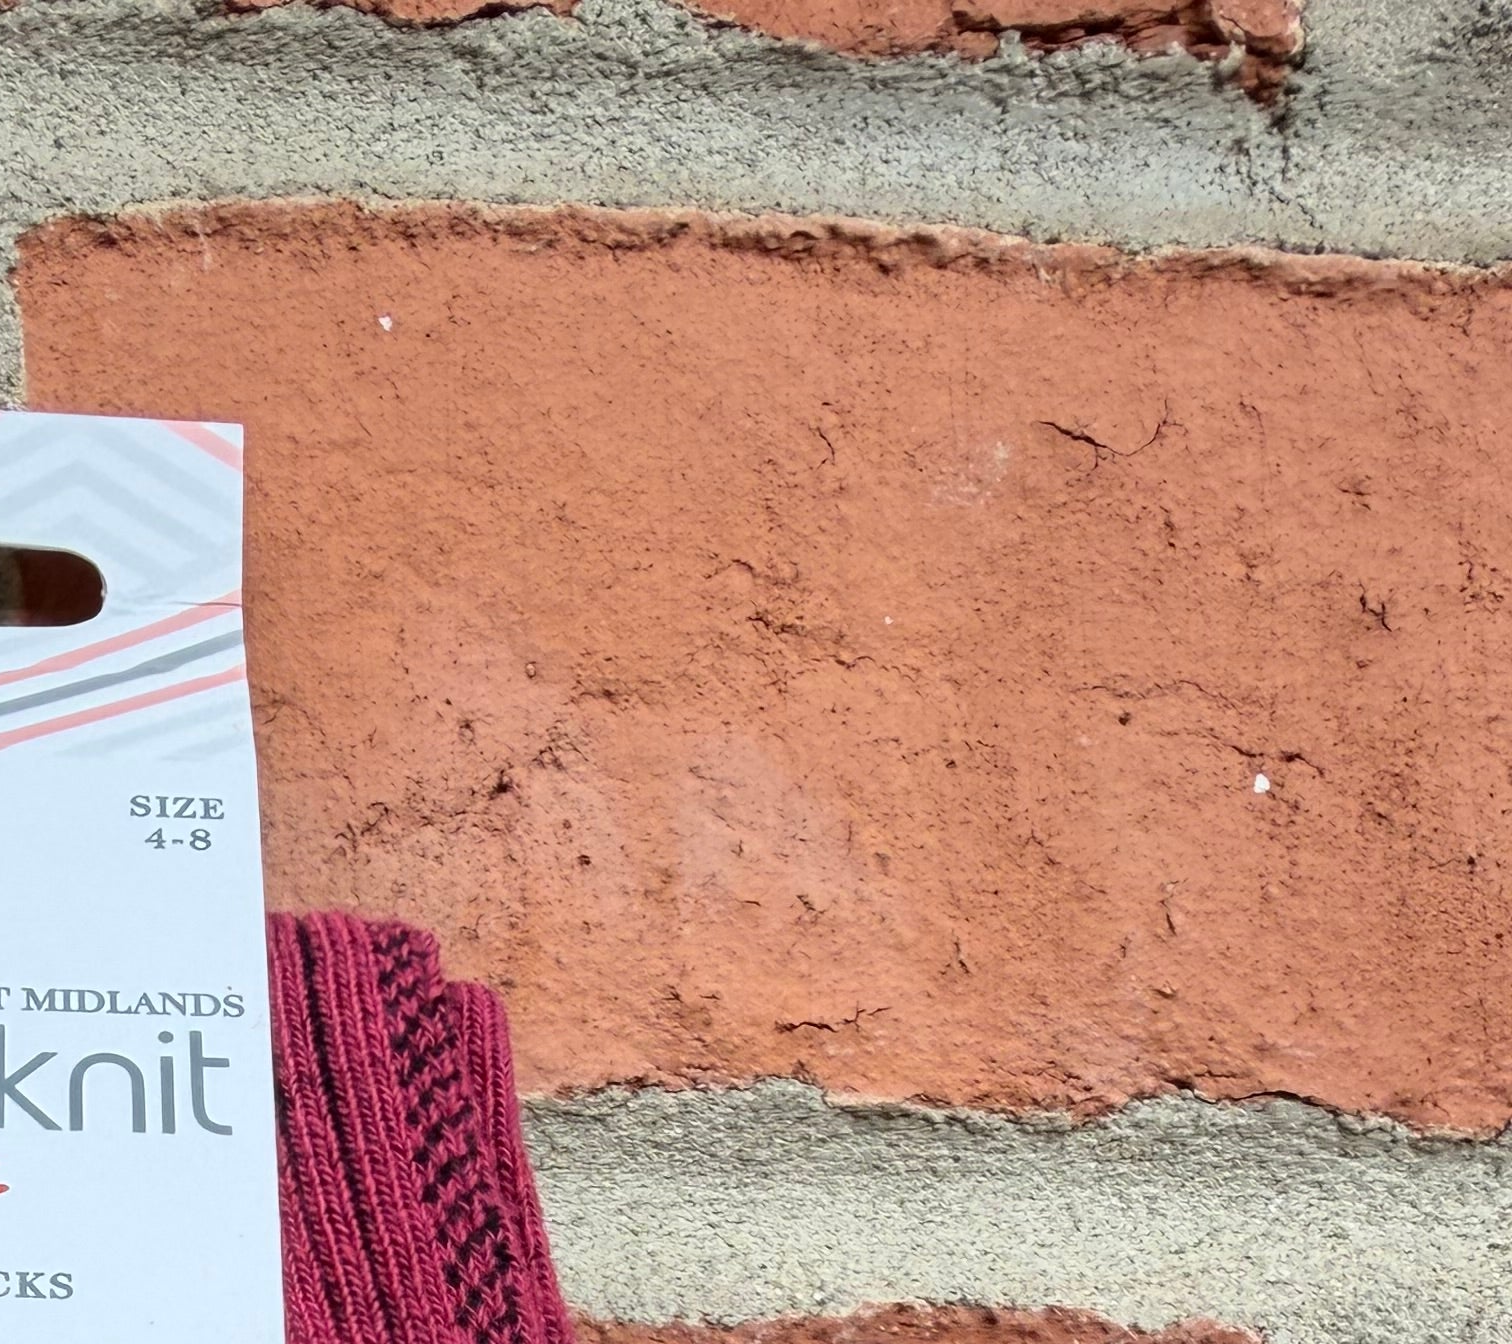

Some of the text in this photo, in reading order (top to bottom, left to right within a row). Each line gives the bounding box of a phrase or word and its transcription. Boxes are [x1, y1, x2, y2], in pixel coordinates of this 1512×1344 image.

[130, 794, 225, 820] SIZE
[144, 827, 212, 851] 4-8
[21, 987, 245, 1018] MIDLANDS
